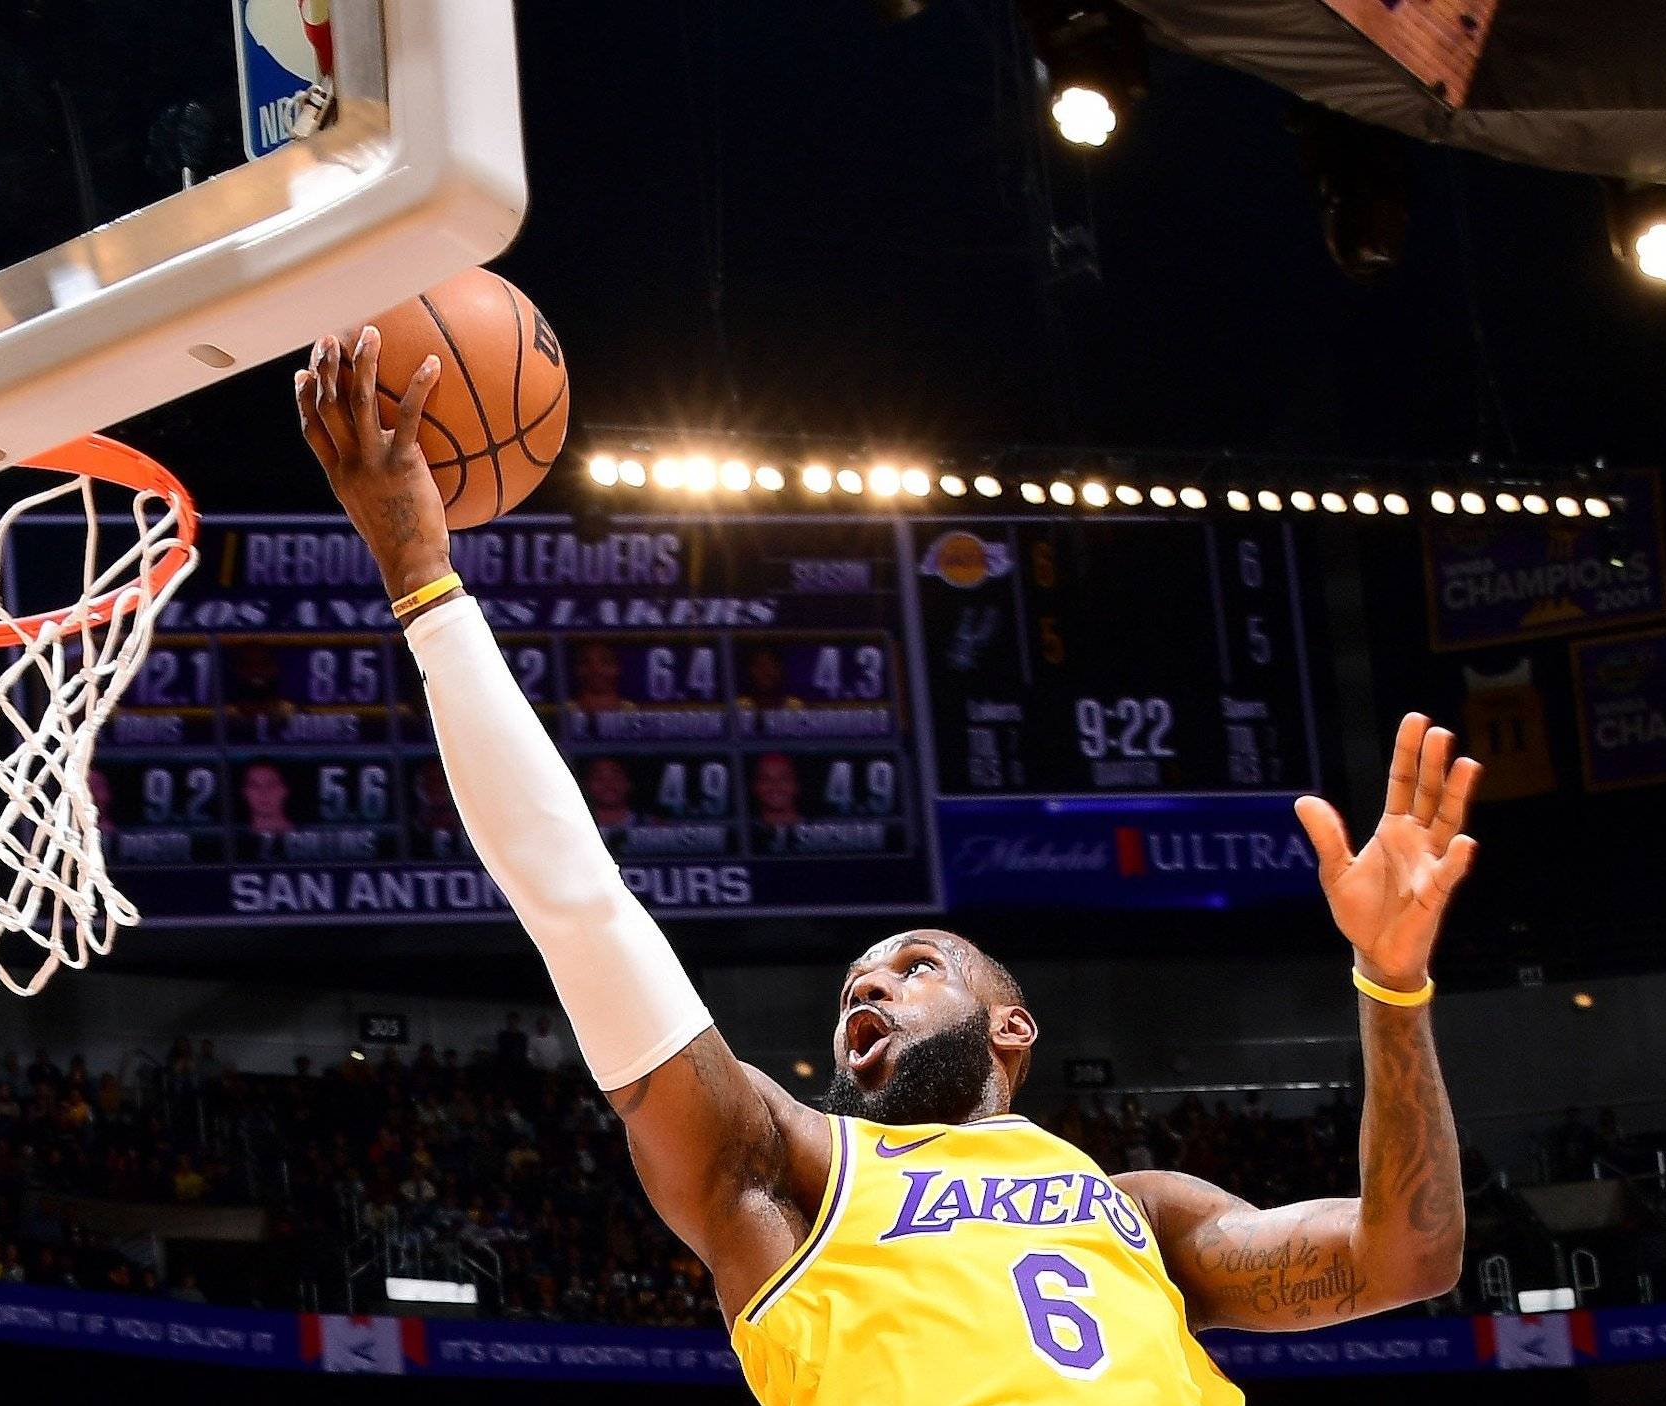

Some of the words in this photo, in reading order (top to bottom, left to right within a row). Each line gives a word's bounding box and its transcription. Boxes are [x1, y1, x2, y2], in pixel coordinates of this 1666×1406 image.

[1075, 697, 1178, 759] 9:22
[1148, 830, 1317, 871] ULTRA
[229, 871, 334, 912] SAN
[347, 869, 503, 910] ANTO
[879, 1169, 1147, 1250] LAKERS
[1009, 1248, 1111, 1382] 6
